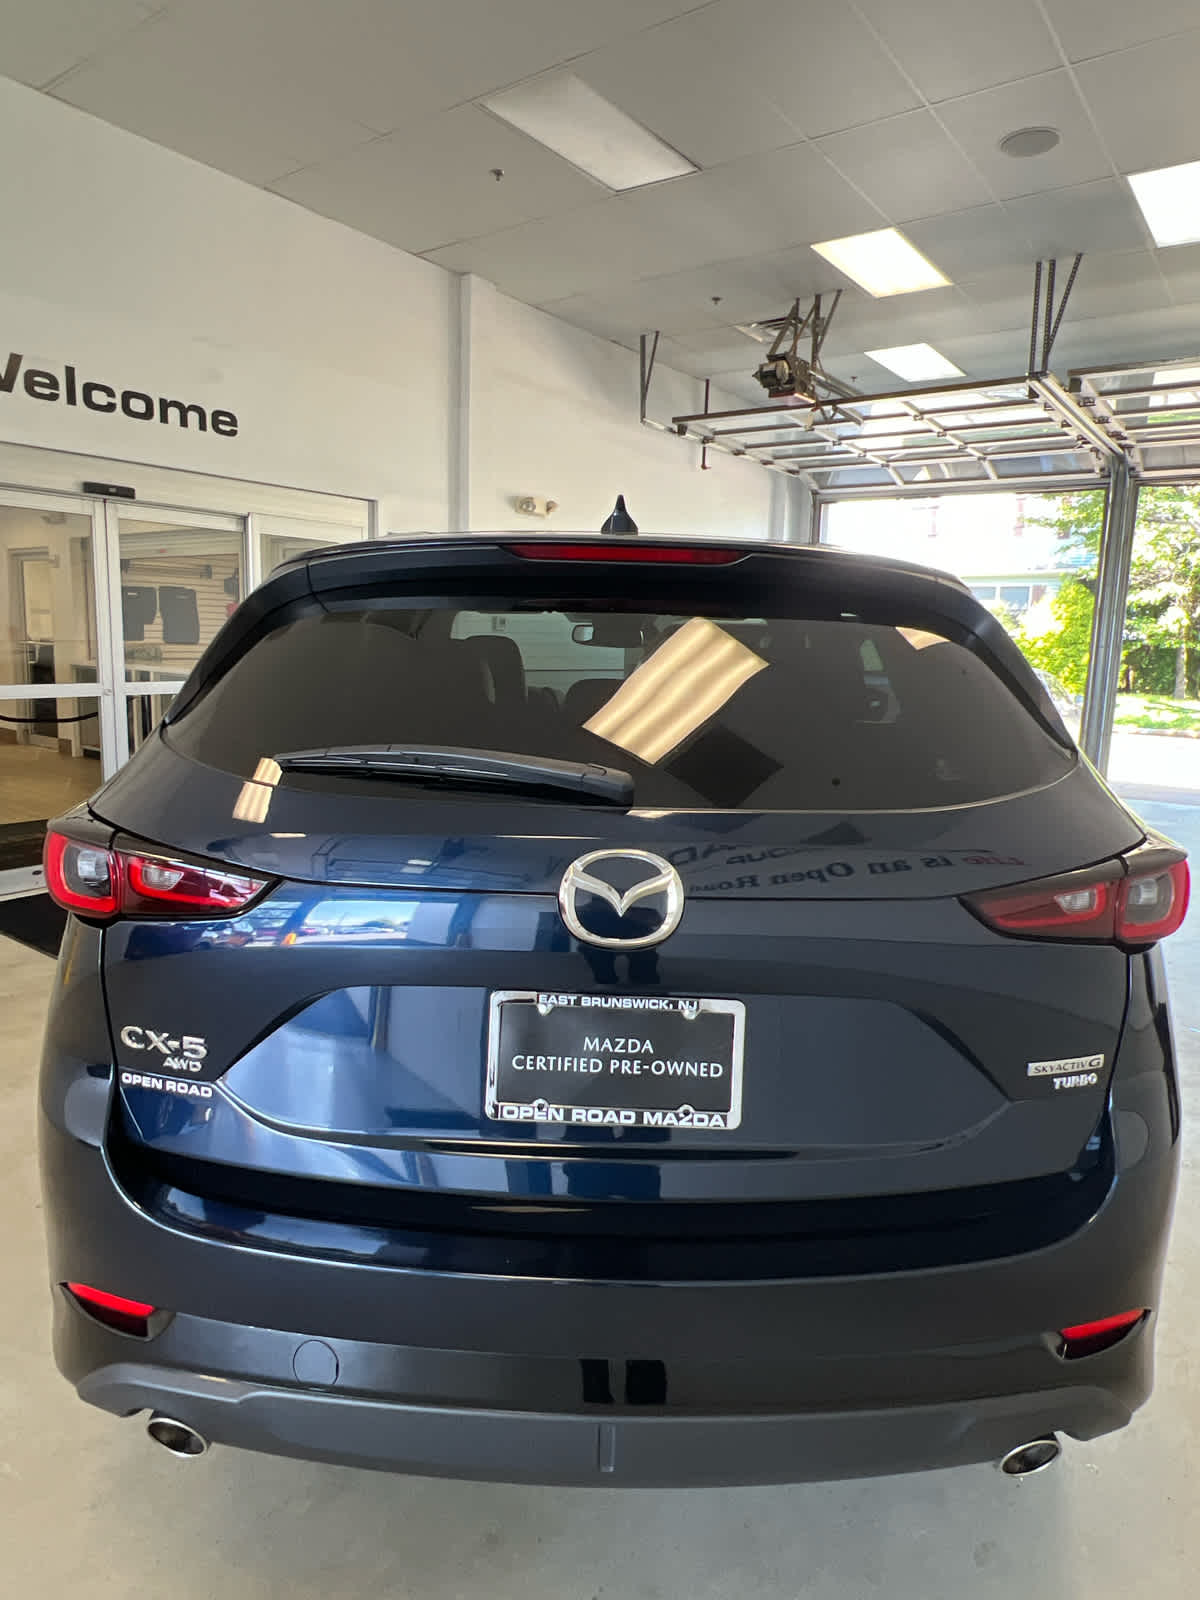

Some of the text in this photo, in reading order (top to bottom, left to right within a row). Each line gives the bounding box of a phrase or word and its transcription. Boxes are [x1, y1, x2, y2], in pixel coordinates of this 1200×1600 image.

[538, 994, 698, 1010] EAST BRUNSWICK, NJ
[120, 1025, 208, 1059] CX-5
[583, 1037, 654, 1054] MAZDA
[162, 1056, 203, 1072] AWD
[511, 1055, 724, 1078] CERTIFIED PRE-OWNED
[121, 1072, 213, 1098] OPEN ROAD
[1052, 1072, 1098, 1090] TURBO
[502, 1105, 725, 1128] OPEN ROAD MAZDA
